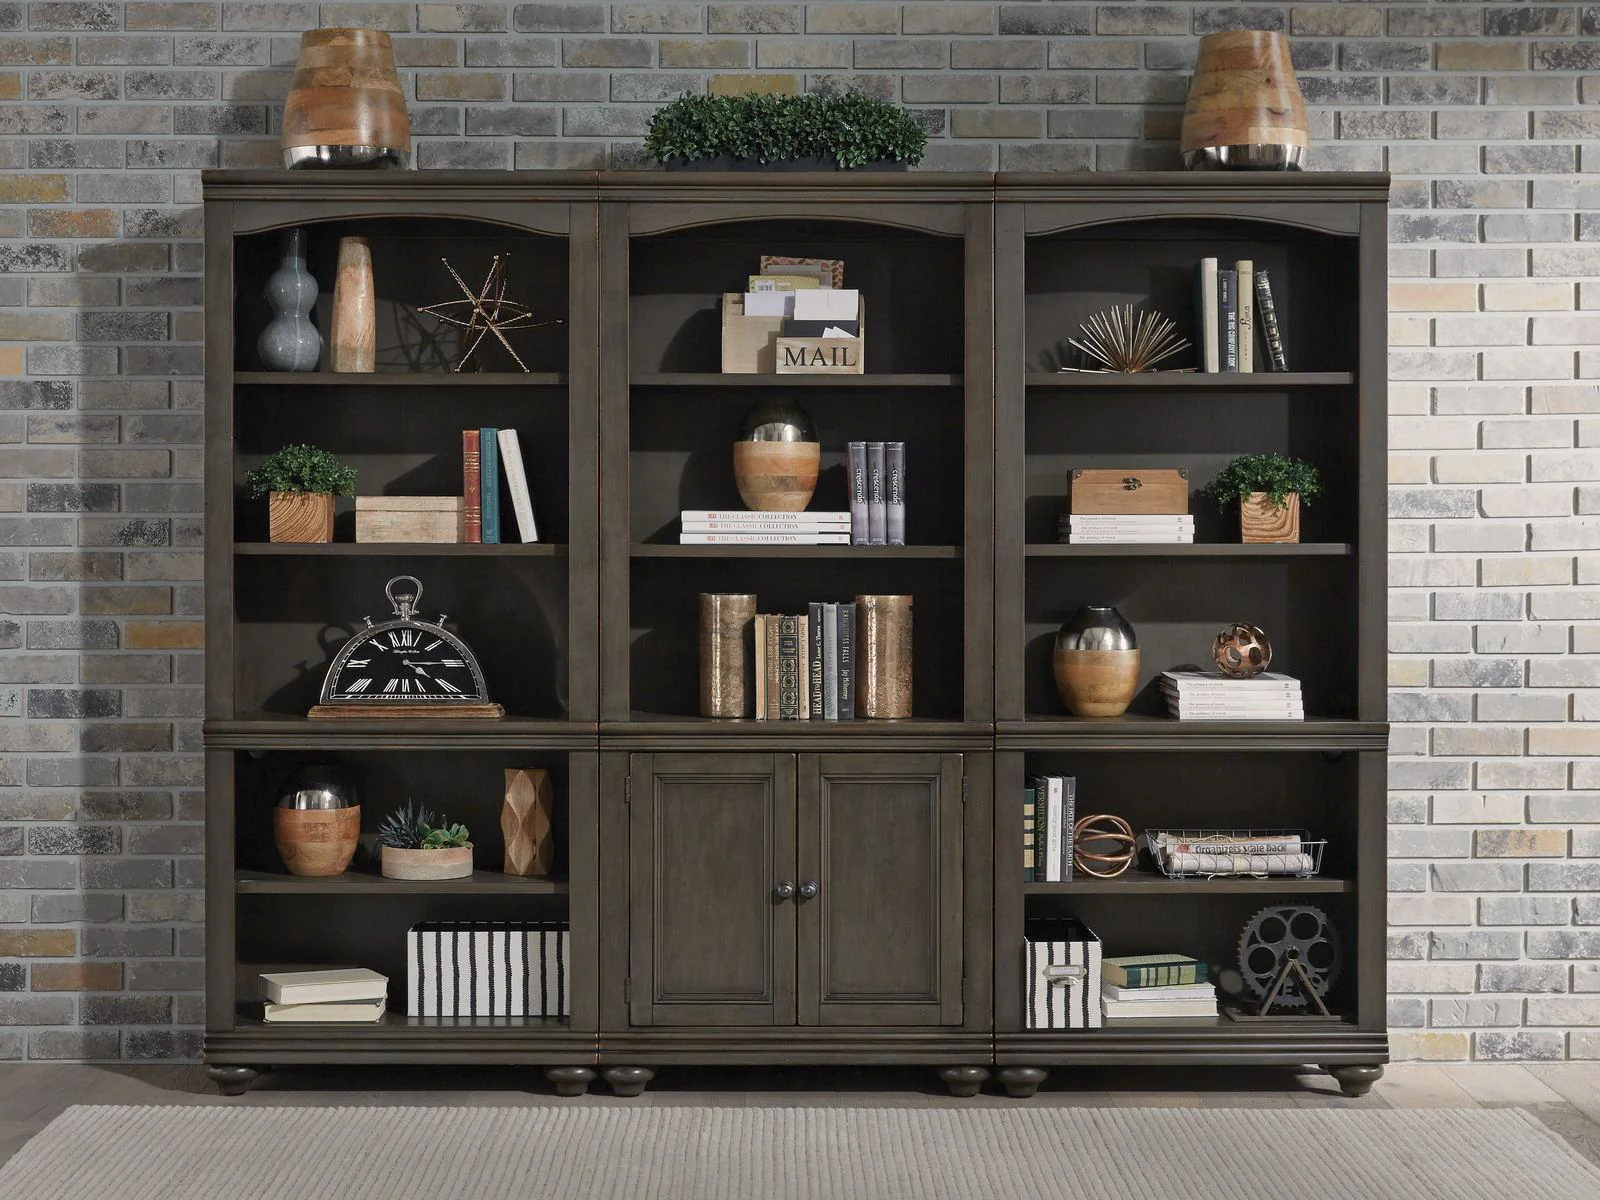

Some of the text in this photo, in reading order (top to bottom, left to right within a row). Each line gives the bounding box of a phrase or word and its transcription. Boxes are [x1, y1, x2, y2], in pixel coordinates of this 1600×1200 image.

[783, 346, 857, 367] MAIL
[388, 632, 400, 647] XI
[401, 630, 412, 646] XII
[369, 639, 388, 652] X
[425, 640, 443, 652] II
[347, 659, 371, 668] IX
[441, 660, 465, 668] III
[813, 660, 822, 684] HEAD
[813, 691, 822, 714] HEAD
[1195, 843, 1286, 855] Organizers scale back
